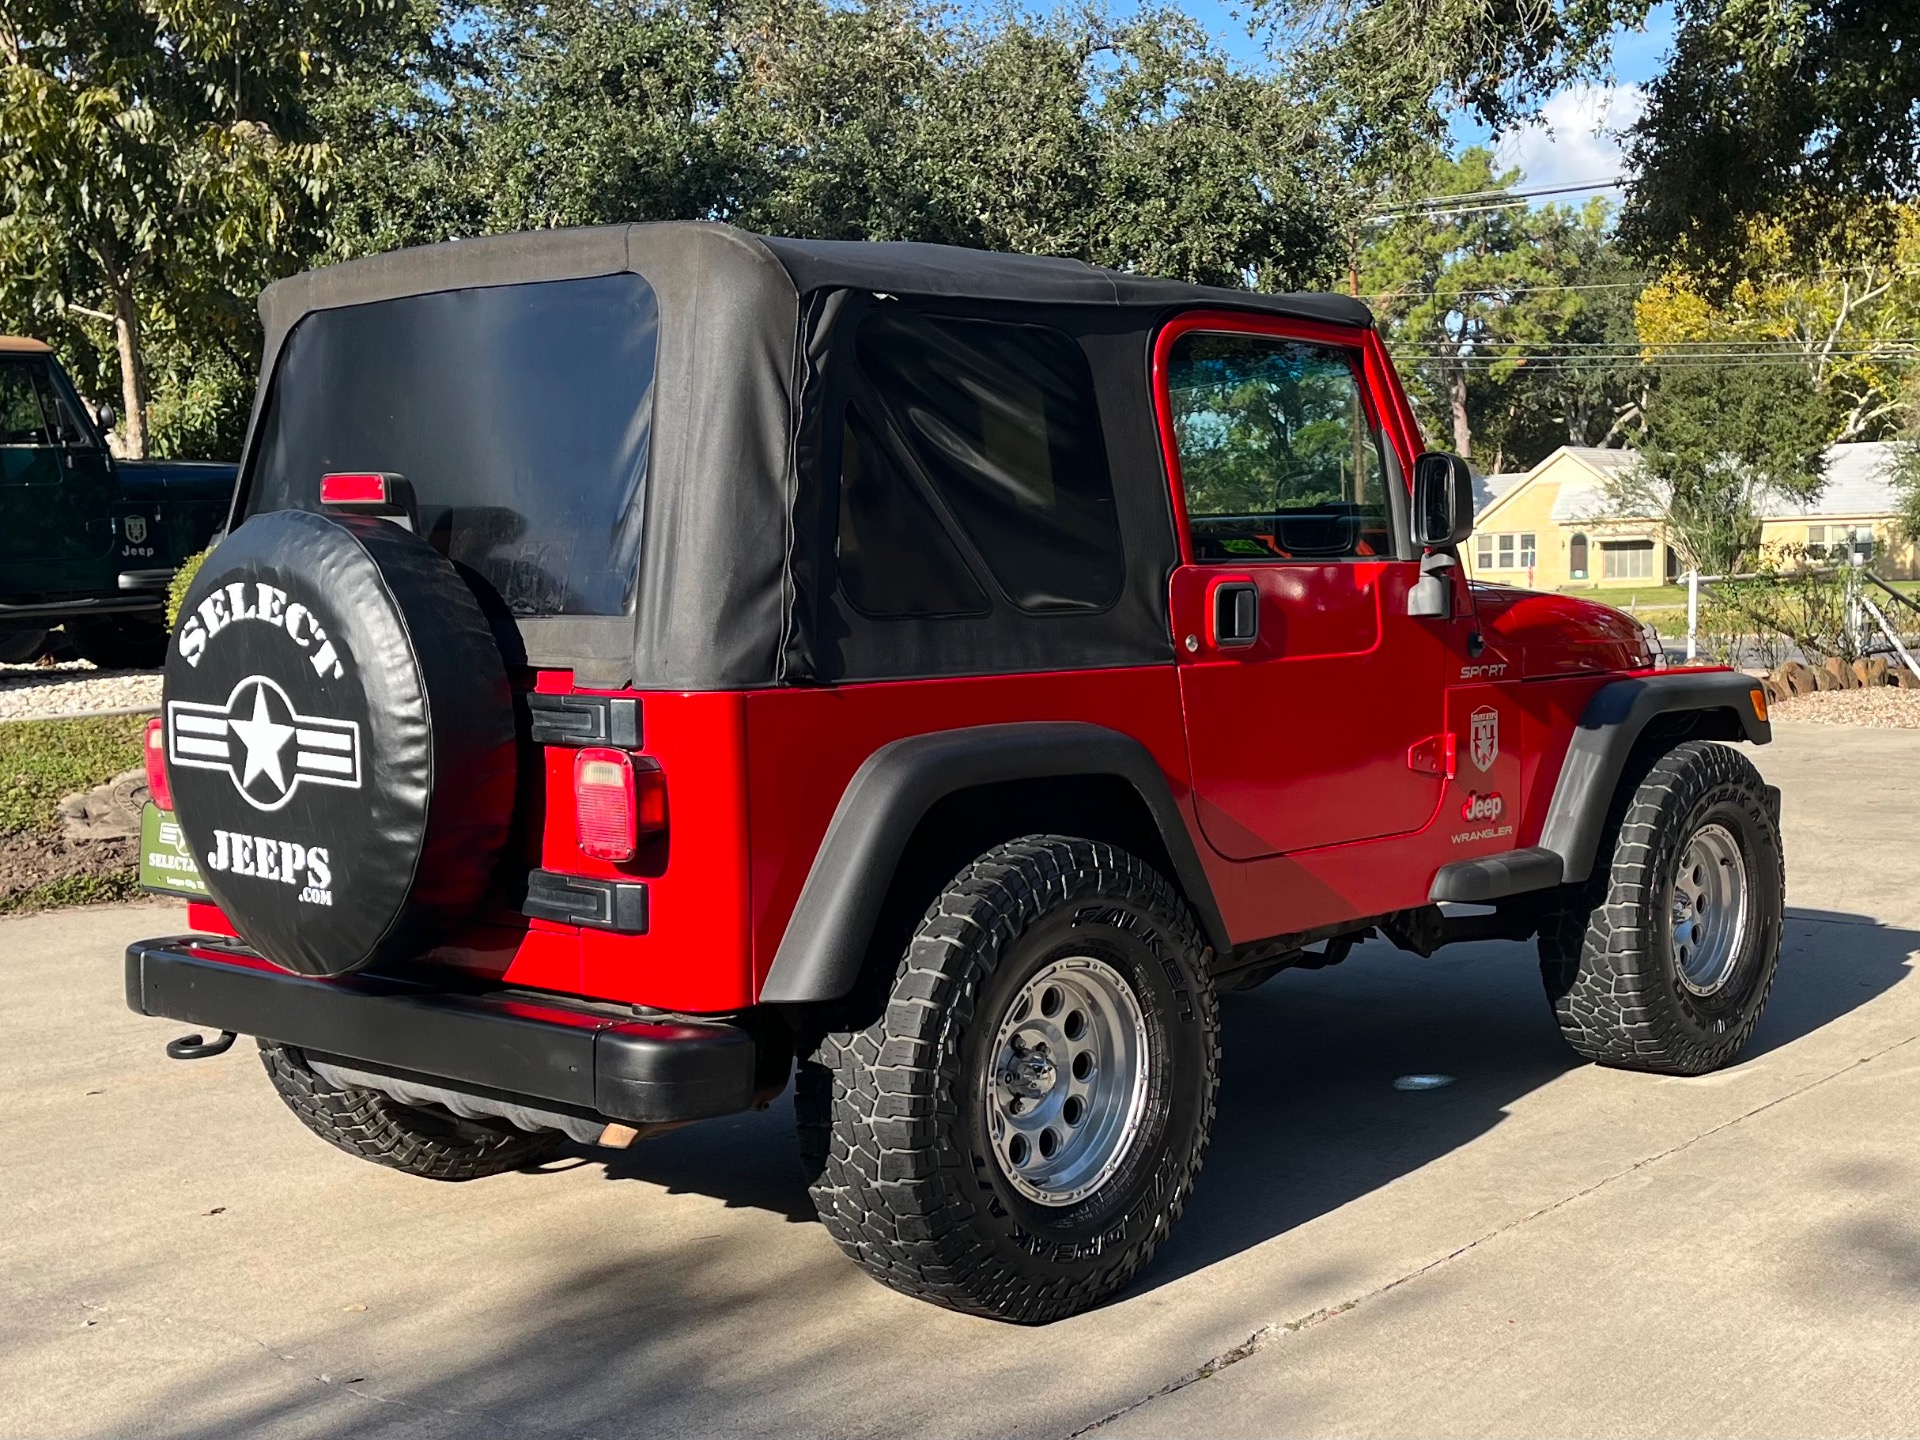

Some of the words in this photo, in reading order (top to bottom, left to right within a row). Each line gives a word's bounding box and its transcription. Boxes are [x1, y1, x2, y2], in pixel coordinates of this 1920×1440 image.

[121, 545, 155, 557] Jeep
[179, 582, 344, 680] SELECT
[1464, 792, 1502, 821] Jeep
[1450, 825, 1513, 844] WRANGLER
[207, 829, 332, 889] JEEPS
[298, 886, 333, 906] .COM
[1070, 905, 1197, 1022] FALKEN
[1004, 1146, 1179, 1264] WILDPEAK
